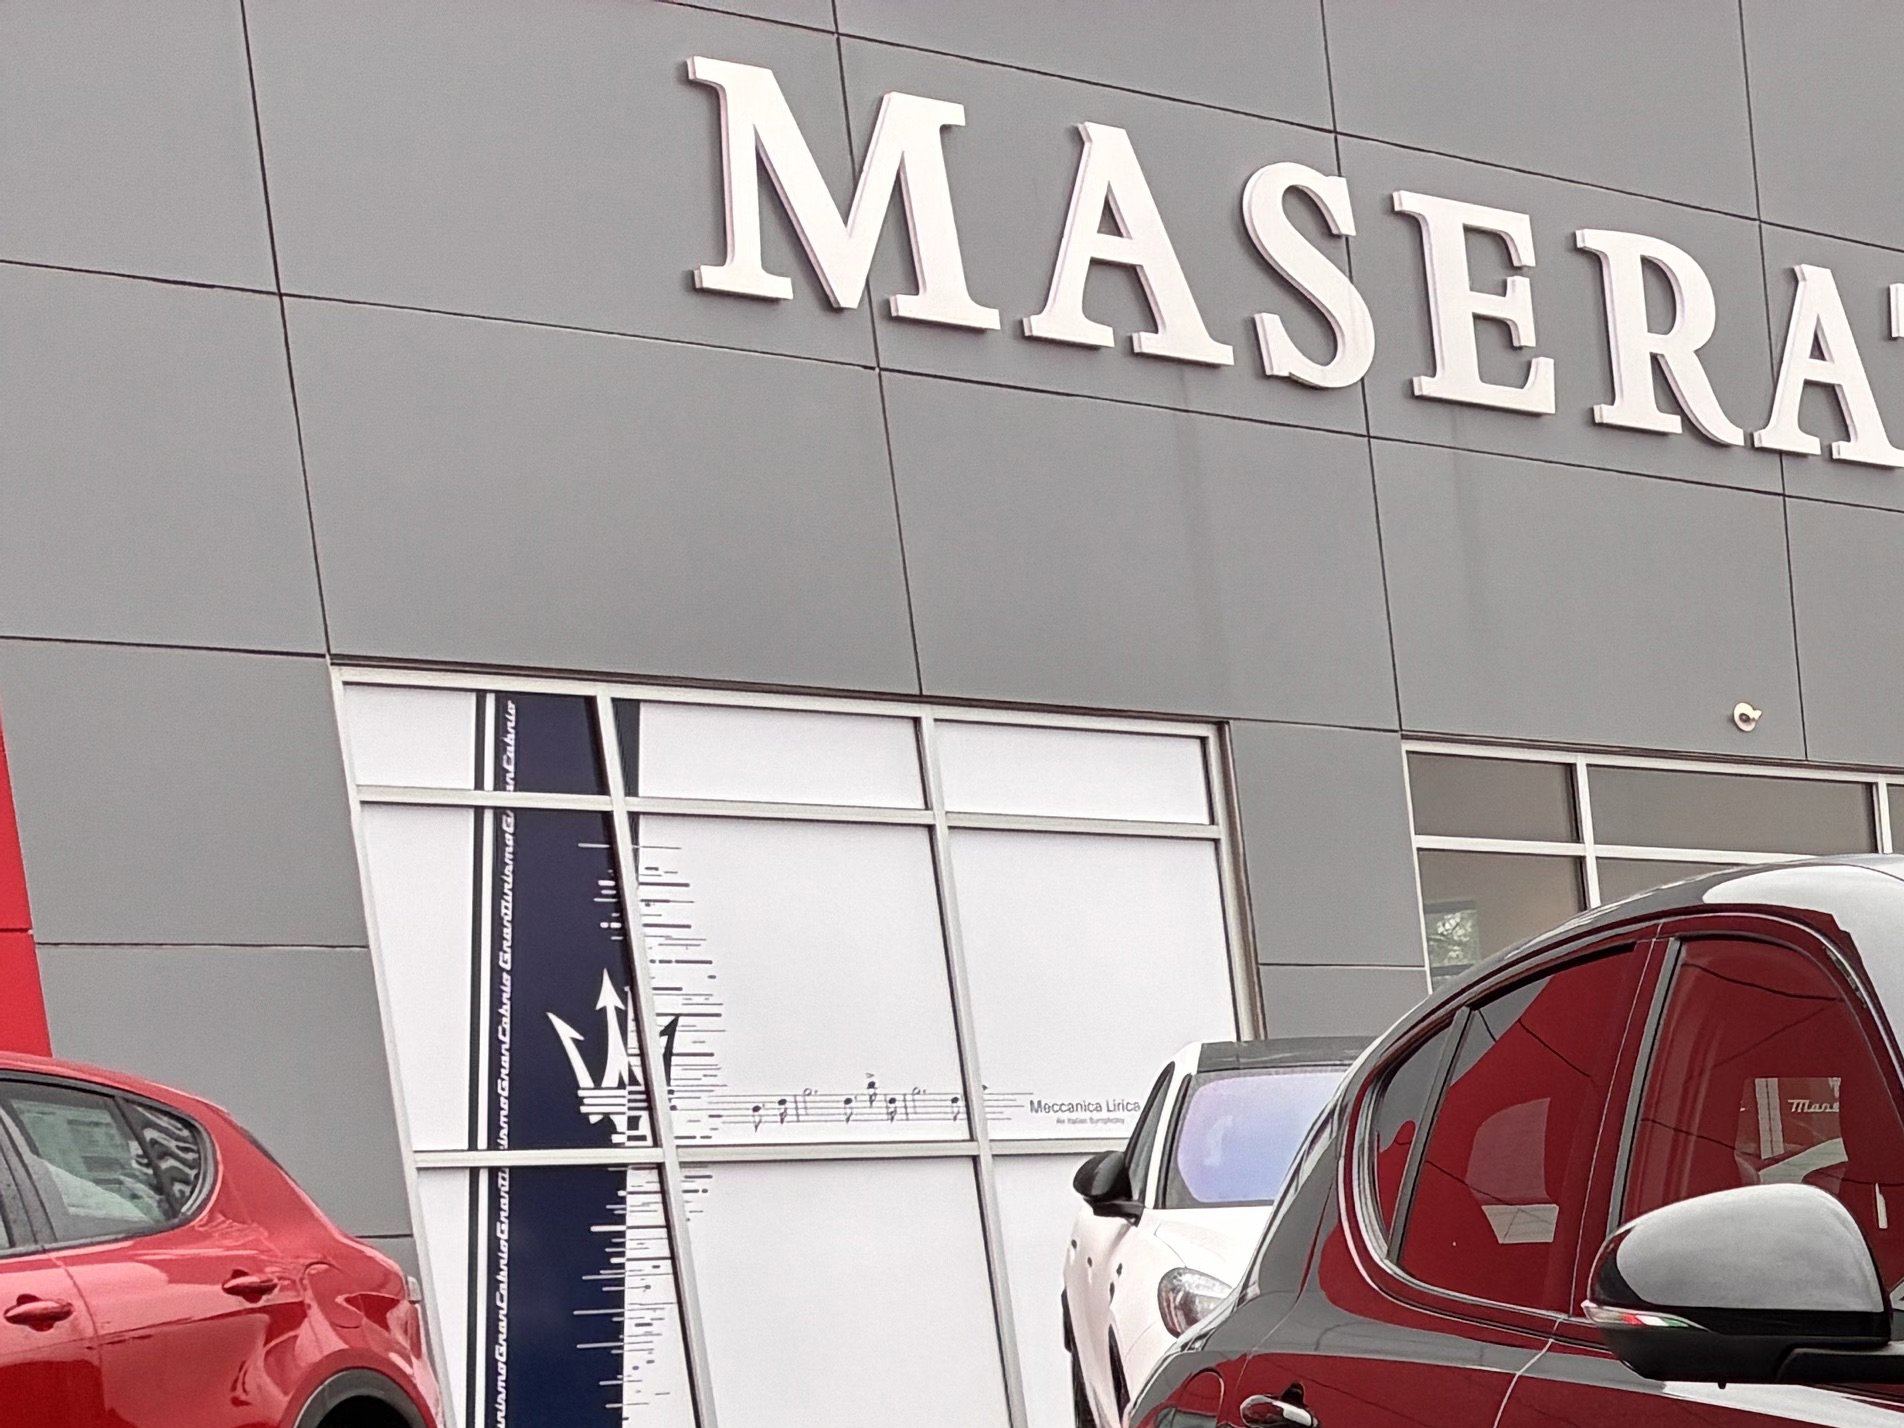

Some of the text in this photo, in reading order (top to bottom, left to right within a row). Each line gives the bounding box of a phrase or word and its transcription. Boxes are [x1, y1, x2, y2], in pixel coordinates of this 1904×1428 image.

[1029, 1098, 1141, 1114] Meccanica Lirica
[496, 1097, 510, 1241] GranTuismo
